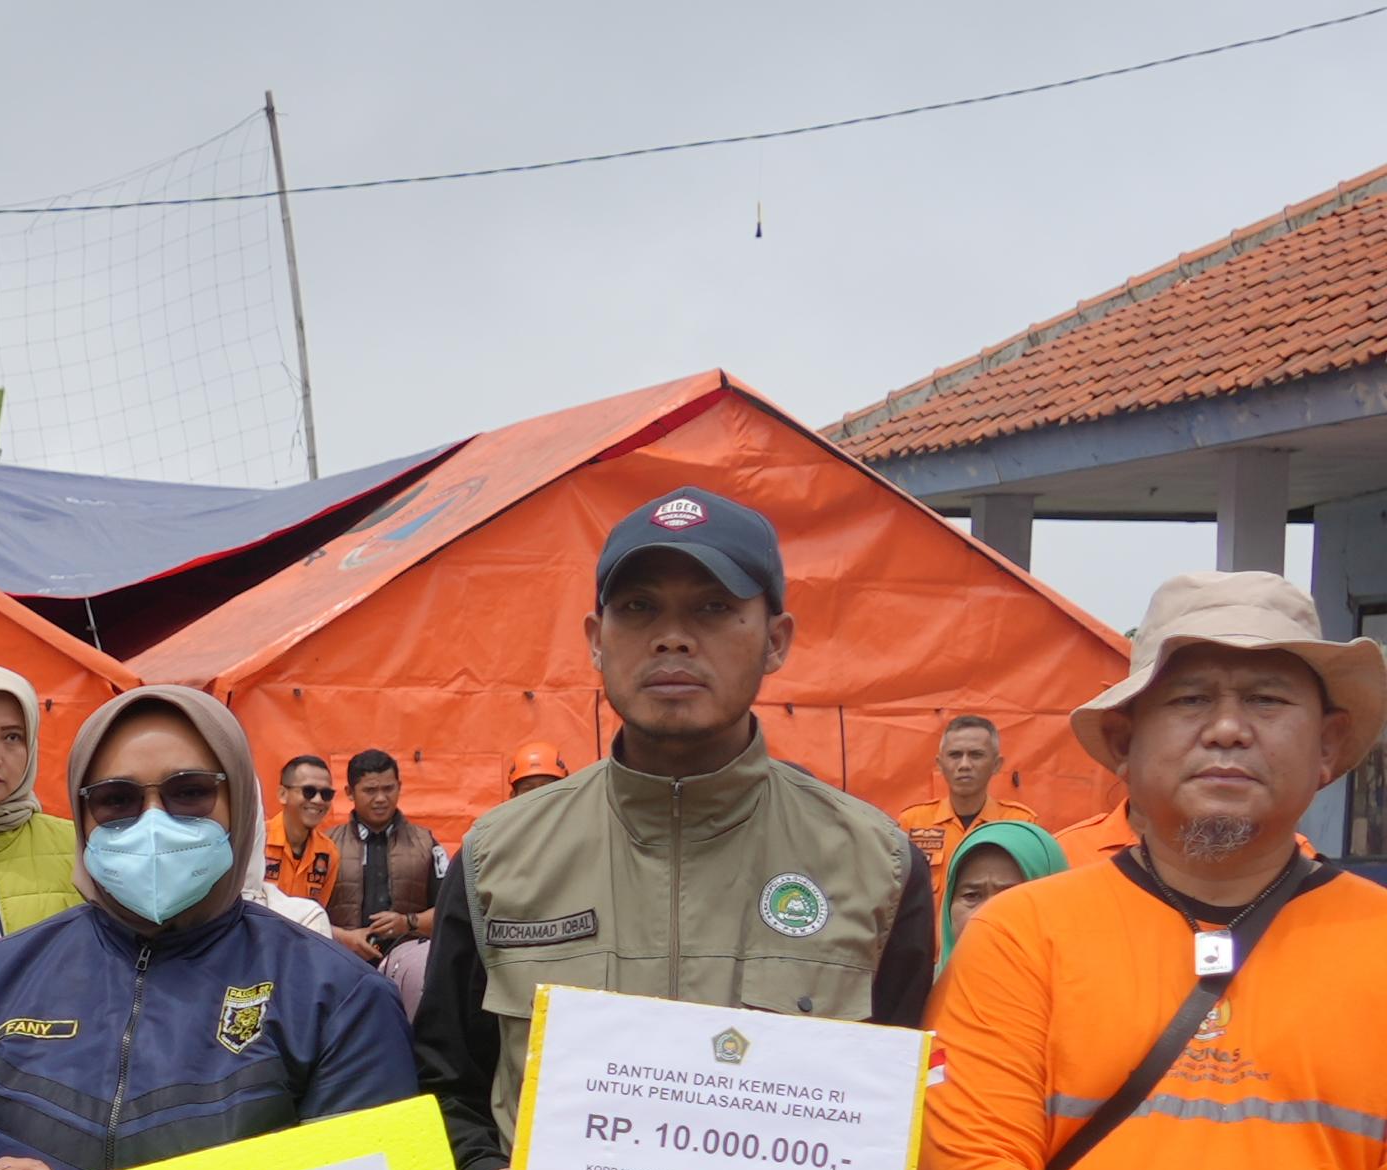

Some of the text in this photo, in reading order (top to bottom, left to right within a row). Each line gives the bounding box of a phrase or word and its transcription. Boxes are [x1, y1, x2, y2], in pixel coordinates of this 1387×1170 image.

[662, 502, 698, 512] EIGER
[491, 916, 591, 939] MUCHAMAD IQBAL
[6, 1022, 52, 1034] FANY
[607, 1062, 845, 1103] BANTUAN DARI KEMENAG RI
[586, 1079, 862, 1125] UNTUK PEMULASARAN JENAZAH
[585, 1113, 640, 1145] RP.
